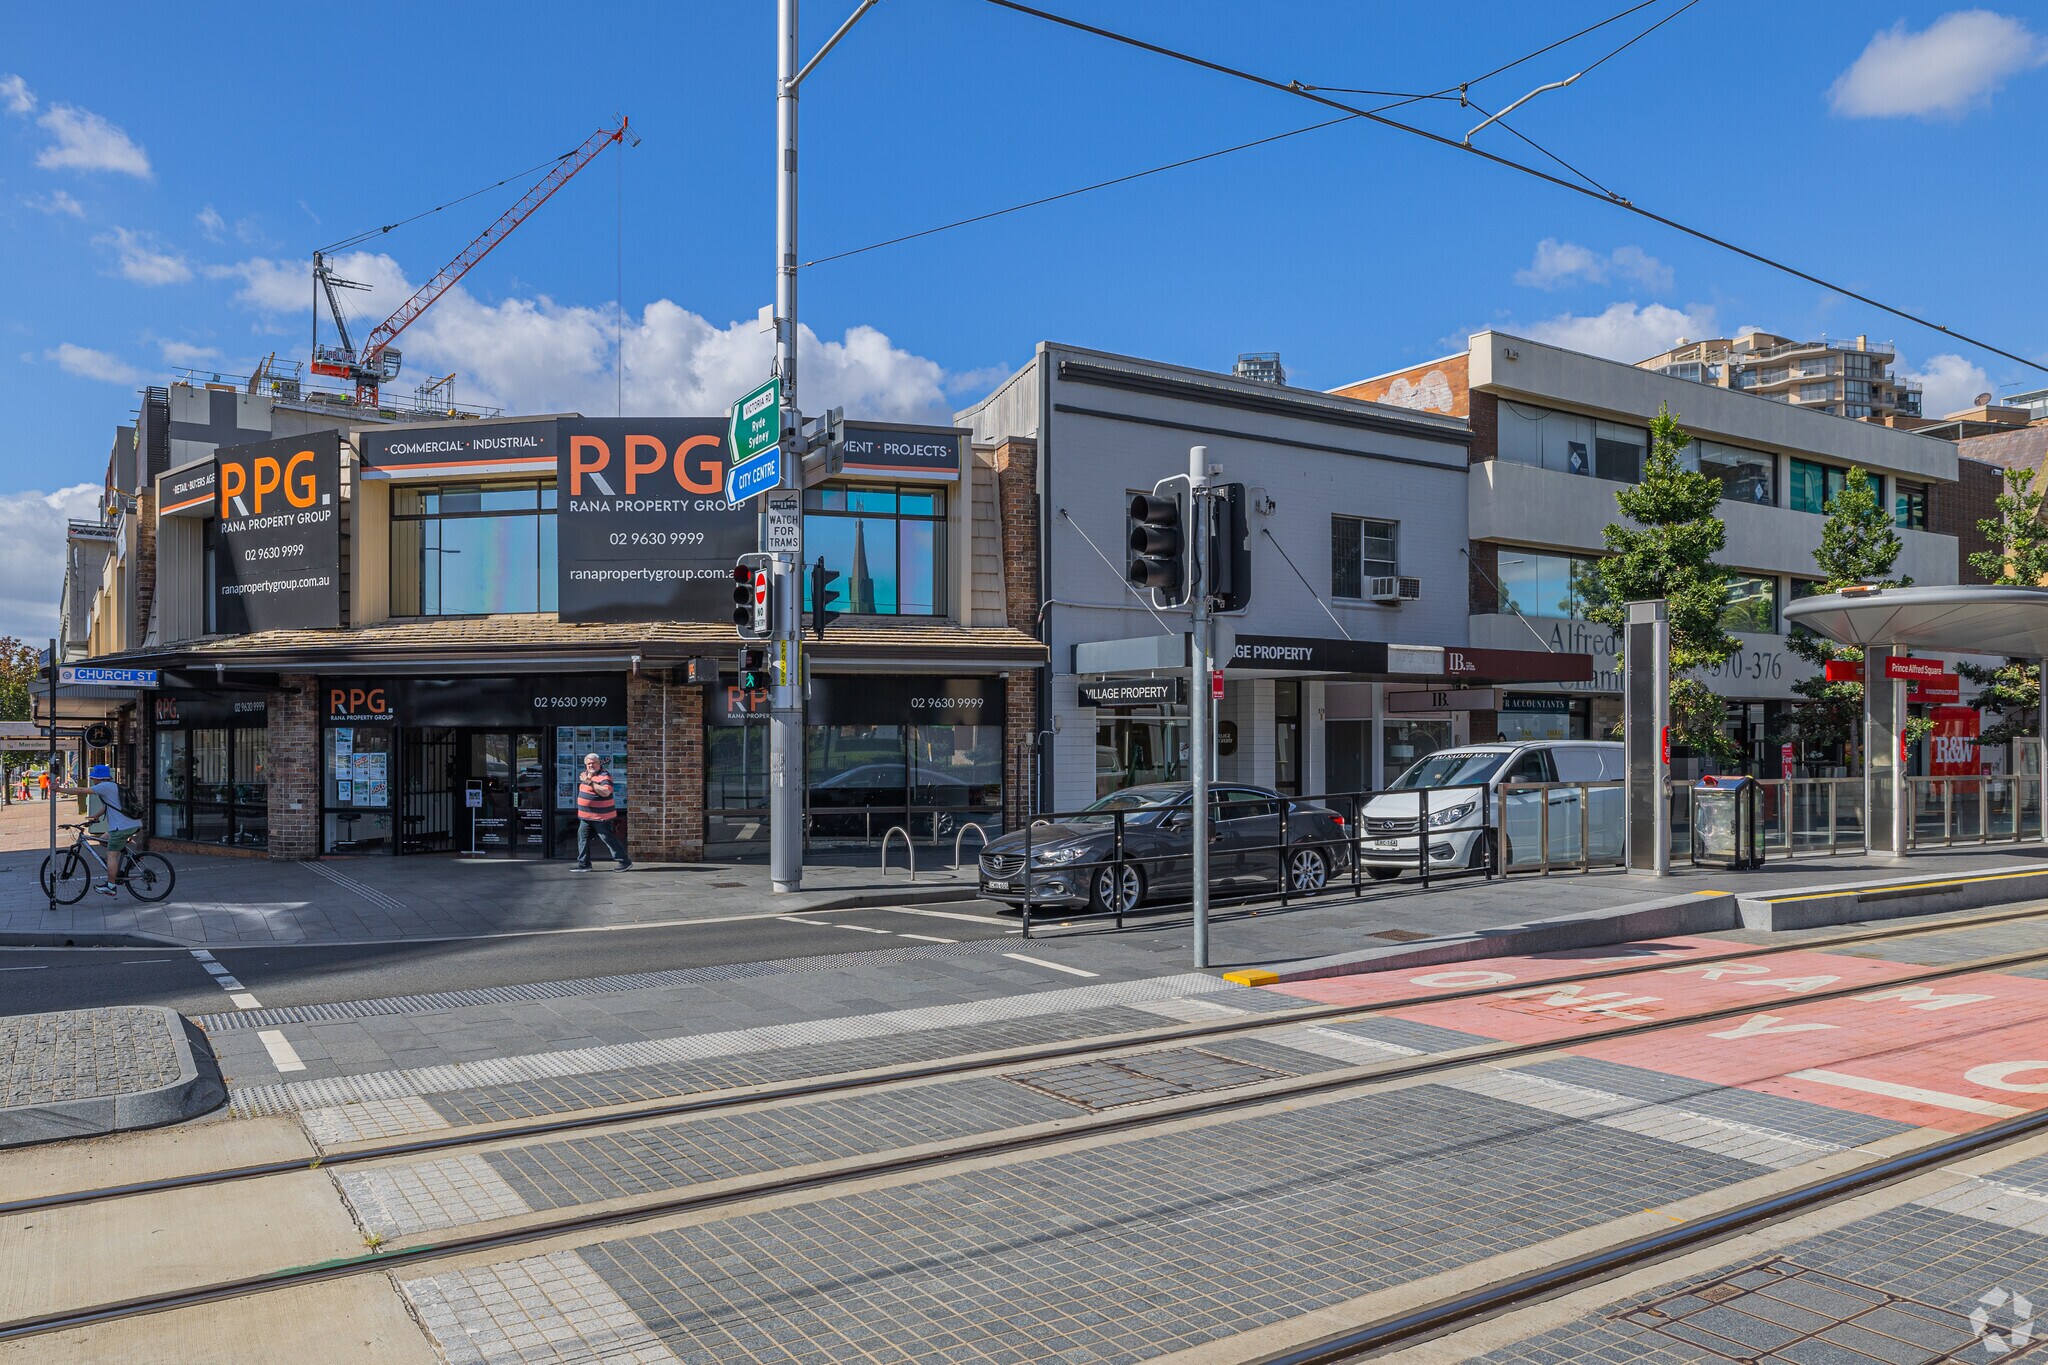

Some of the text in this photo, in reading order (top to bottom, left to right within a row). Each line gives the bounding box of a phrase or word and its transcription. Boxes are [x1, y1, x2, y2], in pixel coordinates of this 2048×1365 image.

[745, 393, 772, 415] VICTORIA RD
[751, 418, 766, 432] Ryde
[390, 436, 538, 454] COMMERCIAL INDUSTRIAL
[748, 431, 769, 449] Sydney
[884, 443, 947, 456] PROJECTS
[738, 460, 776, 490] CITY CENTRE
[570, 500, 746, 512] RANA PROPERTY GROUP
[221, 510, 331, 534] RANA PROPERTY GROUP
[769, 515, 798, 525] WATCH
[774, 527, 794, 536] FOR
[609, 533, 704, 546] 02 9630 9999
[770, 537, 798, 548] TRAMS
[245, 544, 304, 561] 02 9630 9999
[221, 575, 330, 595] ranapropertygroup.com.au
[757, 607, 764, 617] NO
[755, 619, 767, 635] ENTRY
[1550, 622, 1616, 656] Alfred
[1233, 645, 1313, 660] GE PROPERTY
[1449, 652, 1466, 671] IB.
[77, 669, 153, 681] CHURCH ST
[1892, 663, 1942, 676] Prince Alfred Square
[1086, 686, 1168, 699] VILLAGE PROPERTY
[1432, 692, 1449, 706] IB.
[234, 701, 265, 712] 02 9630 9999
[330, 688, 394, 715] RPG.
[534, 696, 607, 707] 02 9630 9999
[911, 698, 984, 708] 02 9630 9999
[1512, 700, 1564, 708] ACCOUNTANTS
[1936, 736, 1974, 763] R&W
